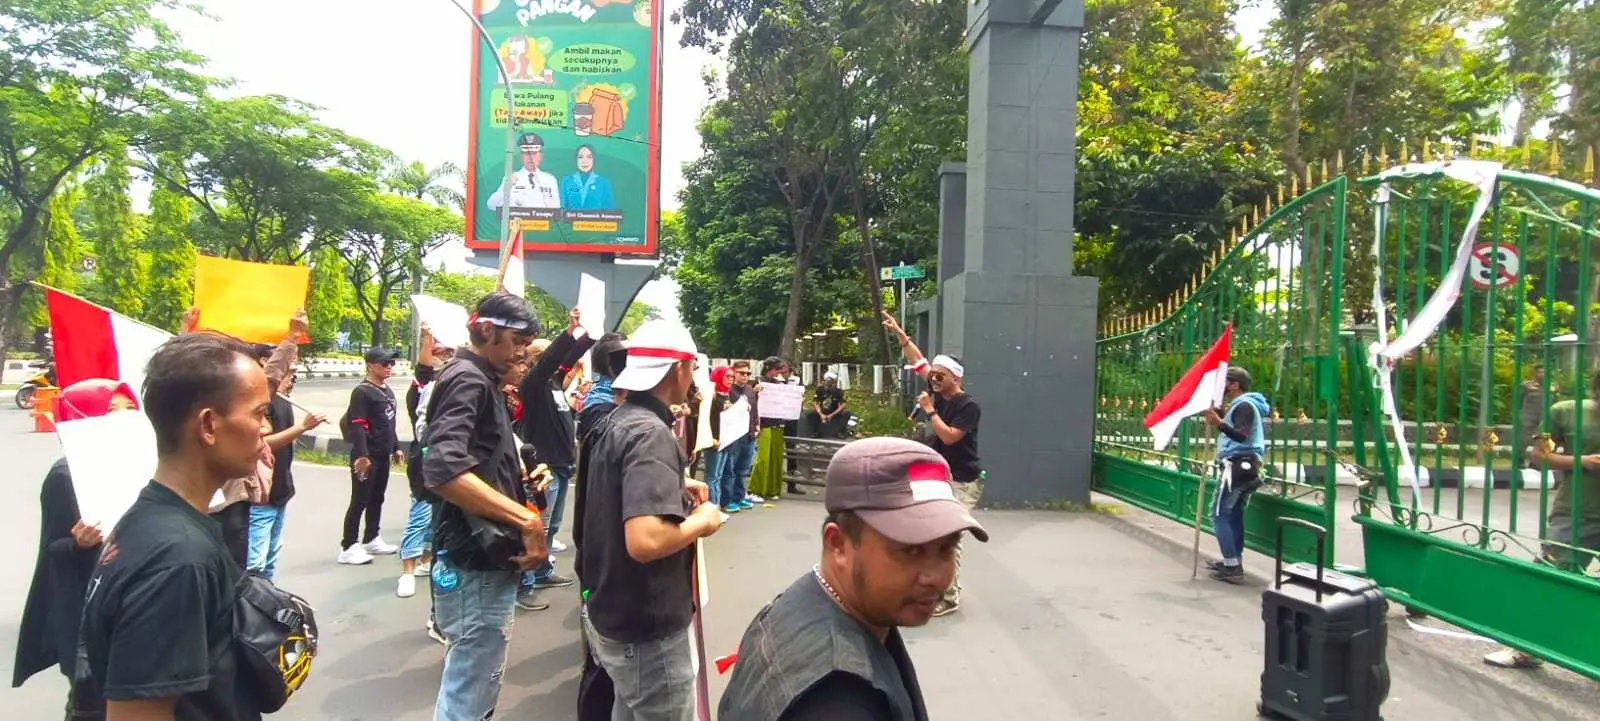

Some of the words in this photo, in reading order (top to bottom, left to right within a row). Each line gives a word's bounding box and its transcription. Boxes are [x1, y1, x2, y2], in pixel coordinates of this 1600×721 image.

[516, 0, 597, 27] PANGAN
[564, 57, 618, 65] secukupnya
[581, 65, 622, 73] habiskan
[527, 92, 555, 101] Pulang
[548, 109, 564, 117] jika
